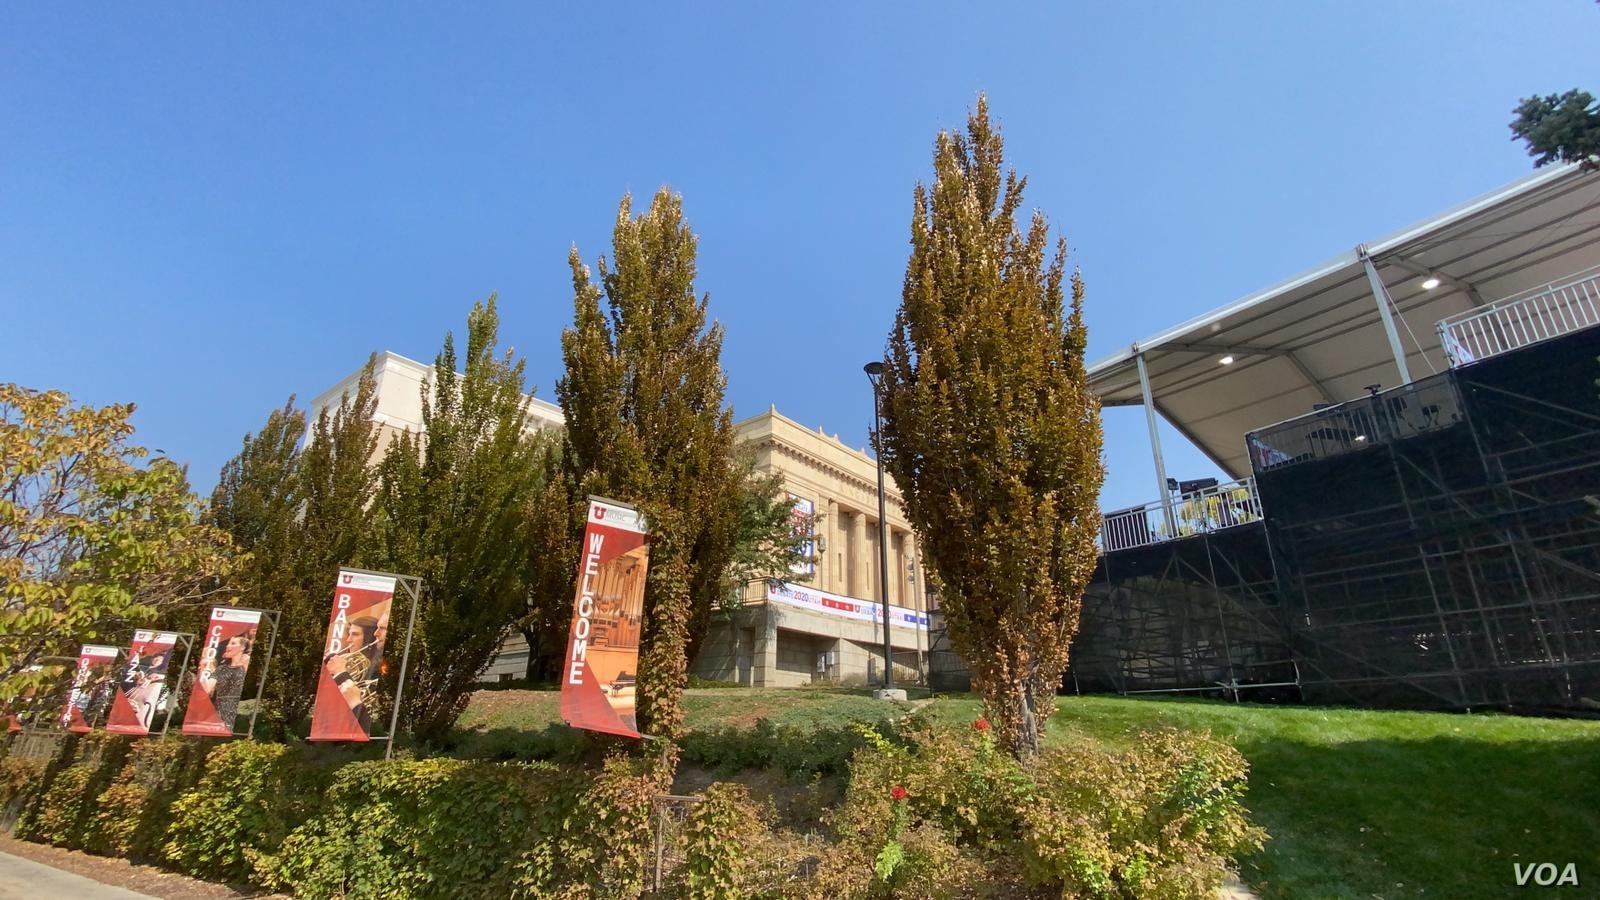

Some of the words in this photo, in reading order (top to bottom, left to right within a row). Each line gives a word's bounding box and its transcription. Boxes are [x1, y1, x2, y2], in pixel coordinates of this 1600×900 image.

[329, 594, 351, 654] BAND
[569, 532, 605, 685] WELCOME
[794, 590, 809, 603] 2020
[199, 625, 223, 681] CHOIR
